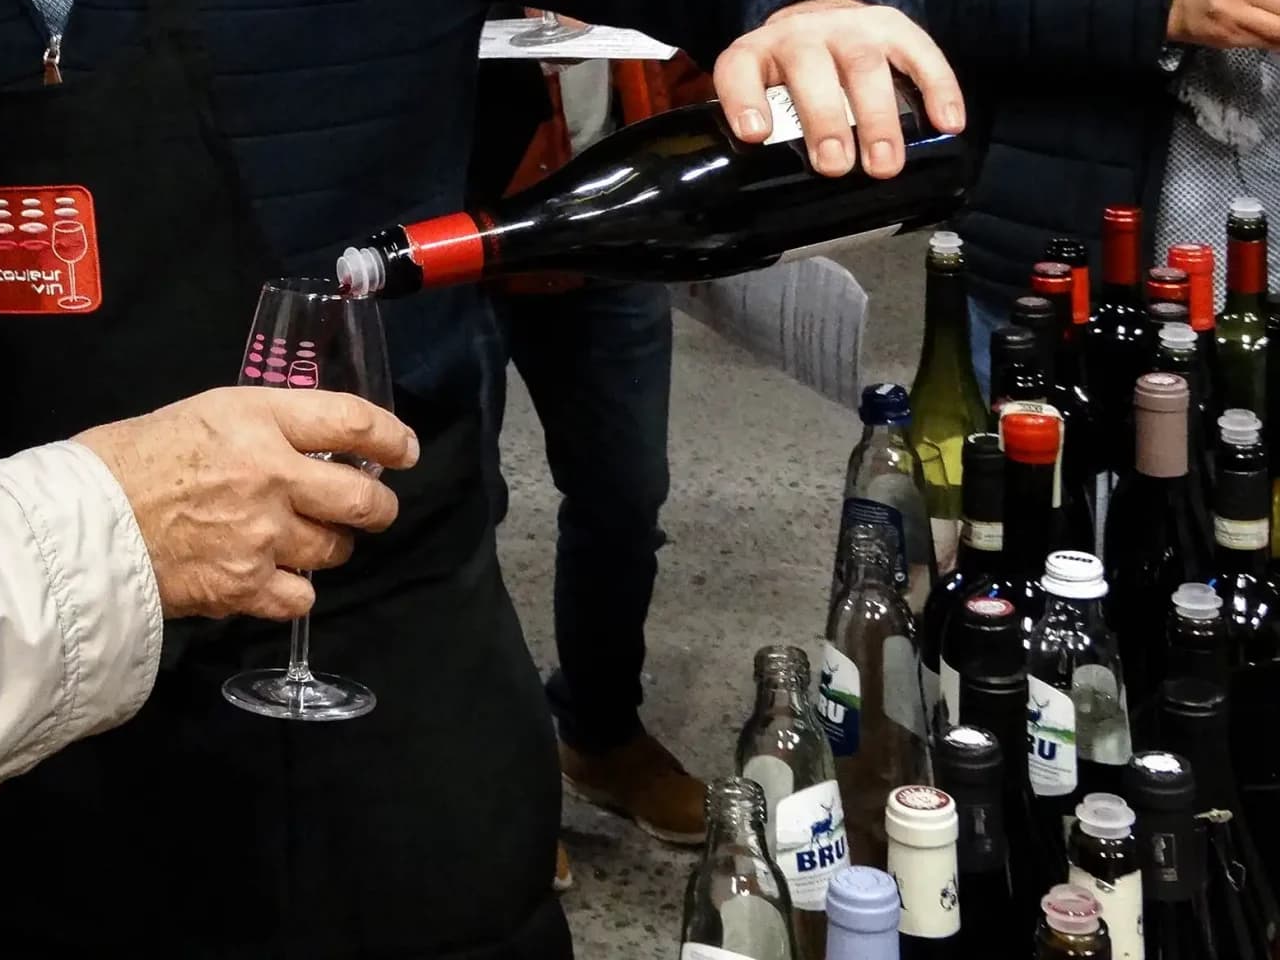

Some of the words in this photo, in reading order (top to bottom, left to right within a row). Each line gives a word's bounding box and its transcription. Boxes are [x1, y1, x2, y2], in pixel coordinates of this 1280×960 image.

[31, 283, 63, 295] vin
[818, 699, 847, 724] RU
[795, 836, 846, 872] BRU
